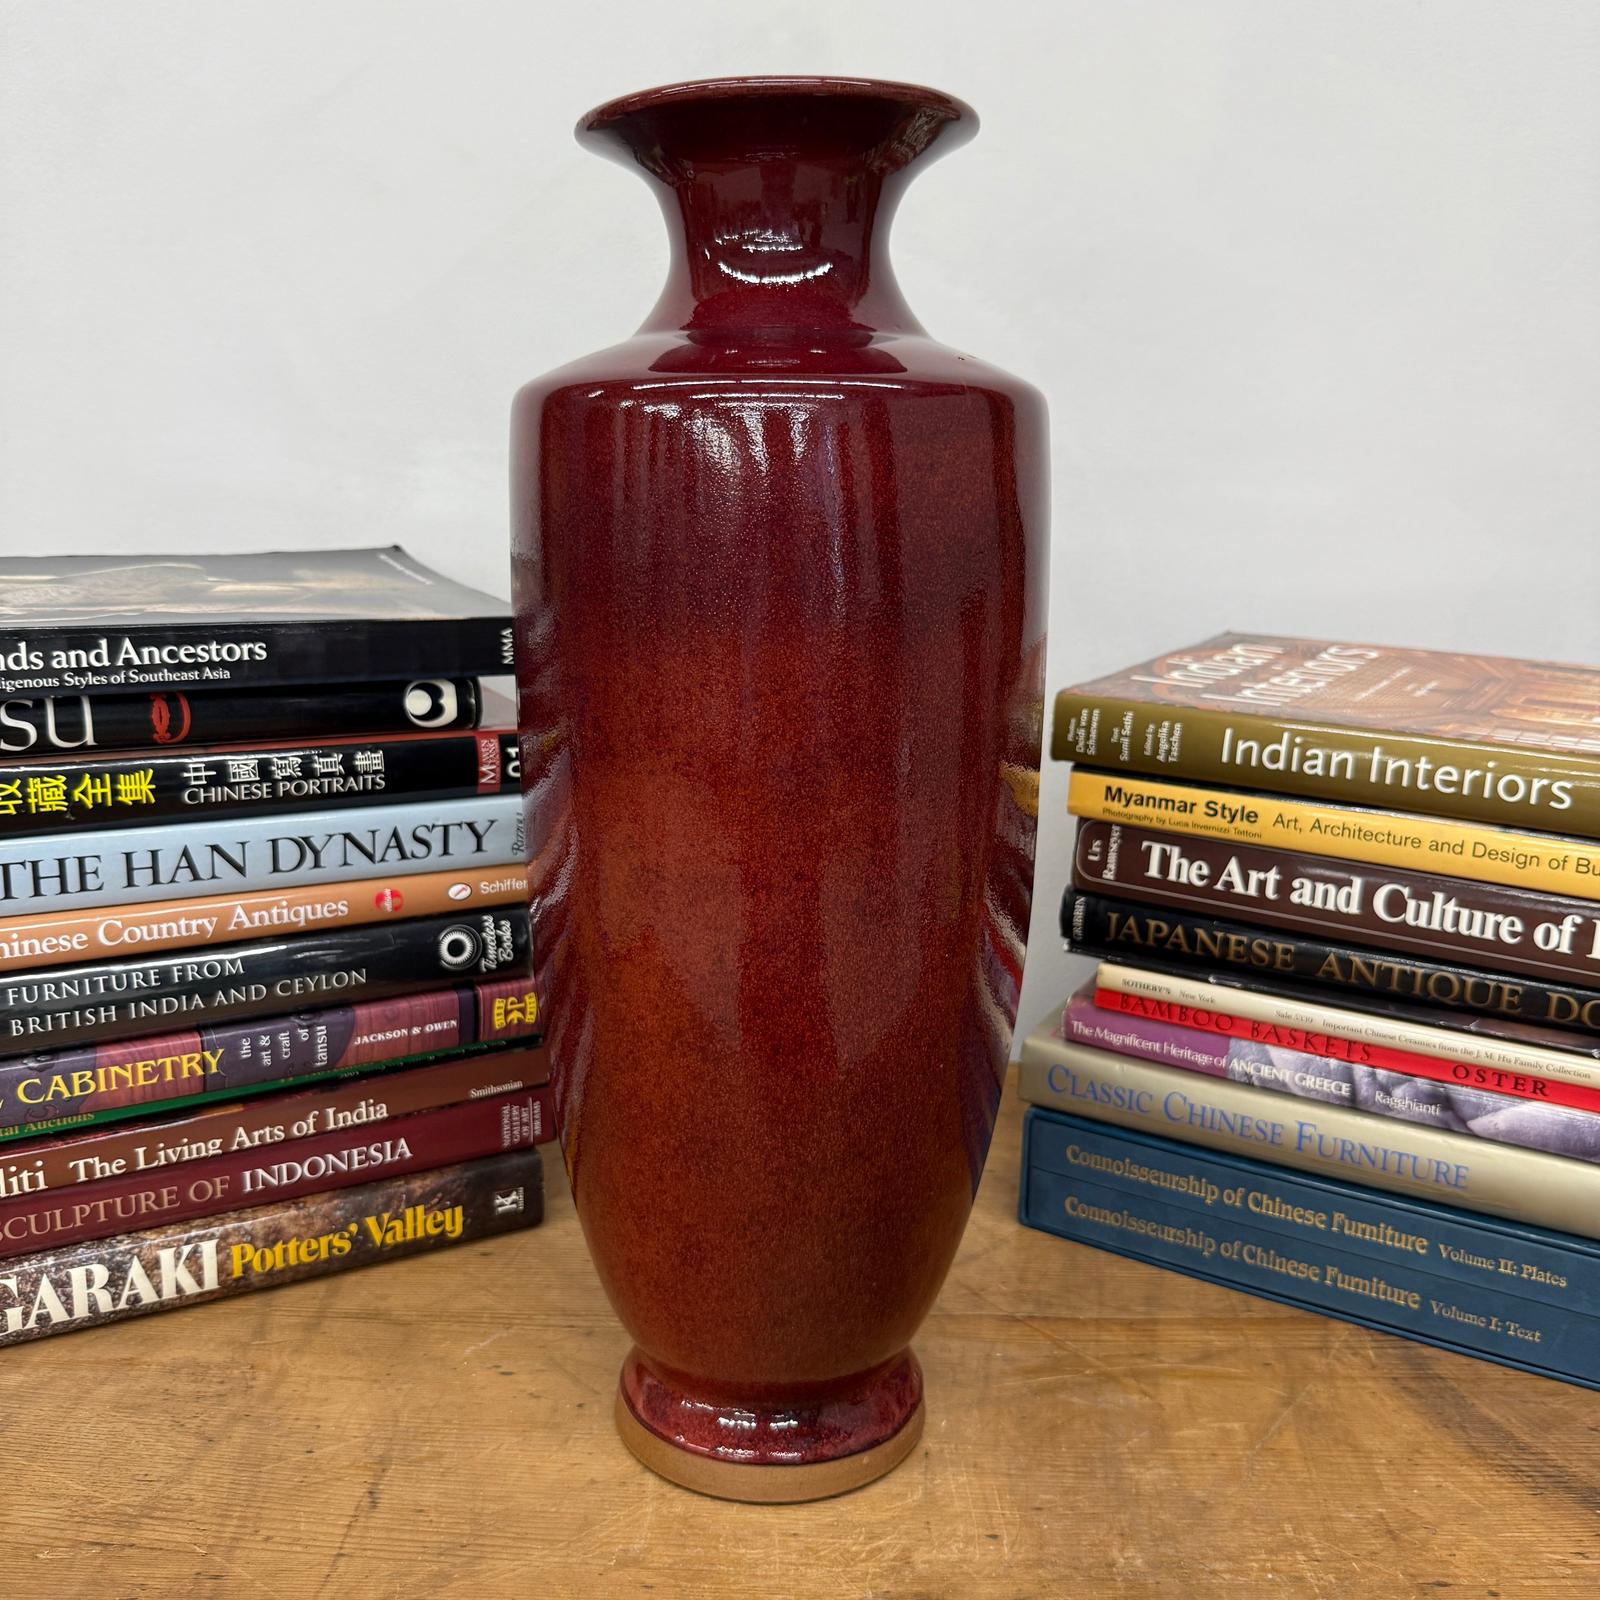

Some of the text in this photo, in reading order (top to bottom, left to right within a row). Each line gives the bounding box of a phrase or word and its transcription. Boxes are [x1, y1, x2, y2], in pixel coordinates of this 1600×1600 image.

[51, 638, 111, 668] and
[116, 637, 268, 666] Ancestors
[0, 667, 231, 692] igenous Styles of Southeast Asia
[1169, 723, 1182, 762] Taschen
[184, 773, 386, 805] CHINESE PORTRAITS
[1221, 728, 1573, 810] Indian Interiors
[1102, 808, 1153, 824] Photography
[1156, 817, 1166, 826] by
[1168, 819, 1190, 829] Luca
[1191, 822, 1230, 833] Invernizzi
[1104, 785, 1197, 814] Myanmar
[1204, 800, 1259, 824] Style
[1273, 814, 1303, 834] Art,
[1310, 817, 1422, 849] Architecture
[1428, 838, 1464, 856] and
[1472, 842, 1540, 869] Design
[1548, 853, 1568, 870] of
[0, 853, 105, 901] THE
[121, 840, 250, 889] HAN
[266, 819, 498, 874] DYNASTY
[1087, 839, 1103, 862] Urs
[1141, 840, 1211, 887] The
[1213, 855, 1282, 900] Art
[1289, 875, 1362, 915] and
[1373, 883, 1524, 944] Culture
[1533, 914, 1582, 955] of
[97, 914, 218, 947] Country
[228, 900, 349, 931] Antiques
[496, 918, 515, 963] Books
[7, 959, 246, 1007] FURNITURE FROM
[1106, 911, 1295, 972] JAPANESE
[1315, 952, 1523, 1016] ANTIQUE
[10, 968, 368, 1037] BRITISH INDIA AND CEYLON
[240, 1037, 252, 1059] the
[260, 1034, 273, 1067] art &
[279, 1030, 291, 1059] craft
[297, 1027, 310, 1042] of
[314, 1025, 328, 1067] tansu
[353, 1018, 458, 1046] JACKSON & OWEN
[1118, 994, 1371, 1062] BAMBOO BASKETS
[1121, 978, 1172, 995] SOTHEBY'S
[1179, 990, 1196, 1001] New
[1197, 993, 1216, 1004] York
[1322, 1019, 1363, 1035] Important
[1364, 1027, 1397, 1040] Chinese
[1398, 1034, 1437, 1048] Ceramics
[1438, 1042, 1458, 1053] from
[1460, 1046, 1474, 1056] the
[1514, 1057, 1543, 1071] Family
[1546, 1063, 1592, 1079] Collection
[16, 1048, 225, 1105] CABINETRY
[1071, 1020, 1351, 1097] The Magnificent Heritage of ANCIENT GREECE
[1452, 1064, 1549, 1097] OSTER
[469, 1078, 524, 1099] Smithsonian
[1375, 1090, 1441, 1117] Ragghianti
[69, 1156, 127, 1184] The
[135, 1137, 223, 1170] Living
[230, 1124, 286, 1151] Arts
[293, 1111, 320, 1138] of
[325, 1098, 389, 1132] India
[1047, 1063, 1470, 1190] CLASSIC CHINESE FURNITURE
[0, 1137, 414, 1241] CULPTURE OF INDONESIA
[1065, 1145, 1220, 1206] Connoisseurship
[1222, 1187, 1246, 1208] of
[1247, 1191, 1328, 1232] Chinese
[1332, 1211, 1429, 1254] Furniture
[1438, 1243, 1495, 1271] Volume
[1521, 1263, 1568, 1288] Plates
[231, 1222, 359, 1280] Potters'
[365, 1203, 464, 1248] Valley
[1064, 1195, 1216, 1257] Connoisseurship
[1219, 1240, 1242, 1261] of
[1242, 1244, 1320, 1282] Chinese
[1325, 1264, 1421, 1310] Furniture
[1430, 1299, 1487, 1328] Volume
[1506, 1320, 1542, 1343] Text
